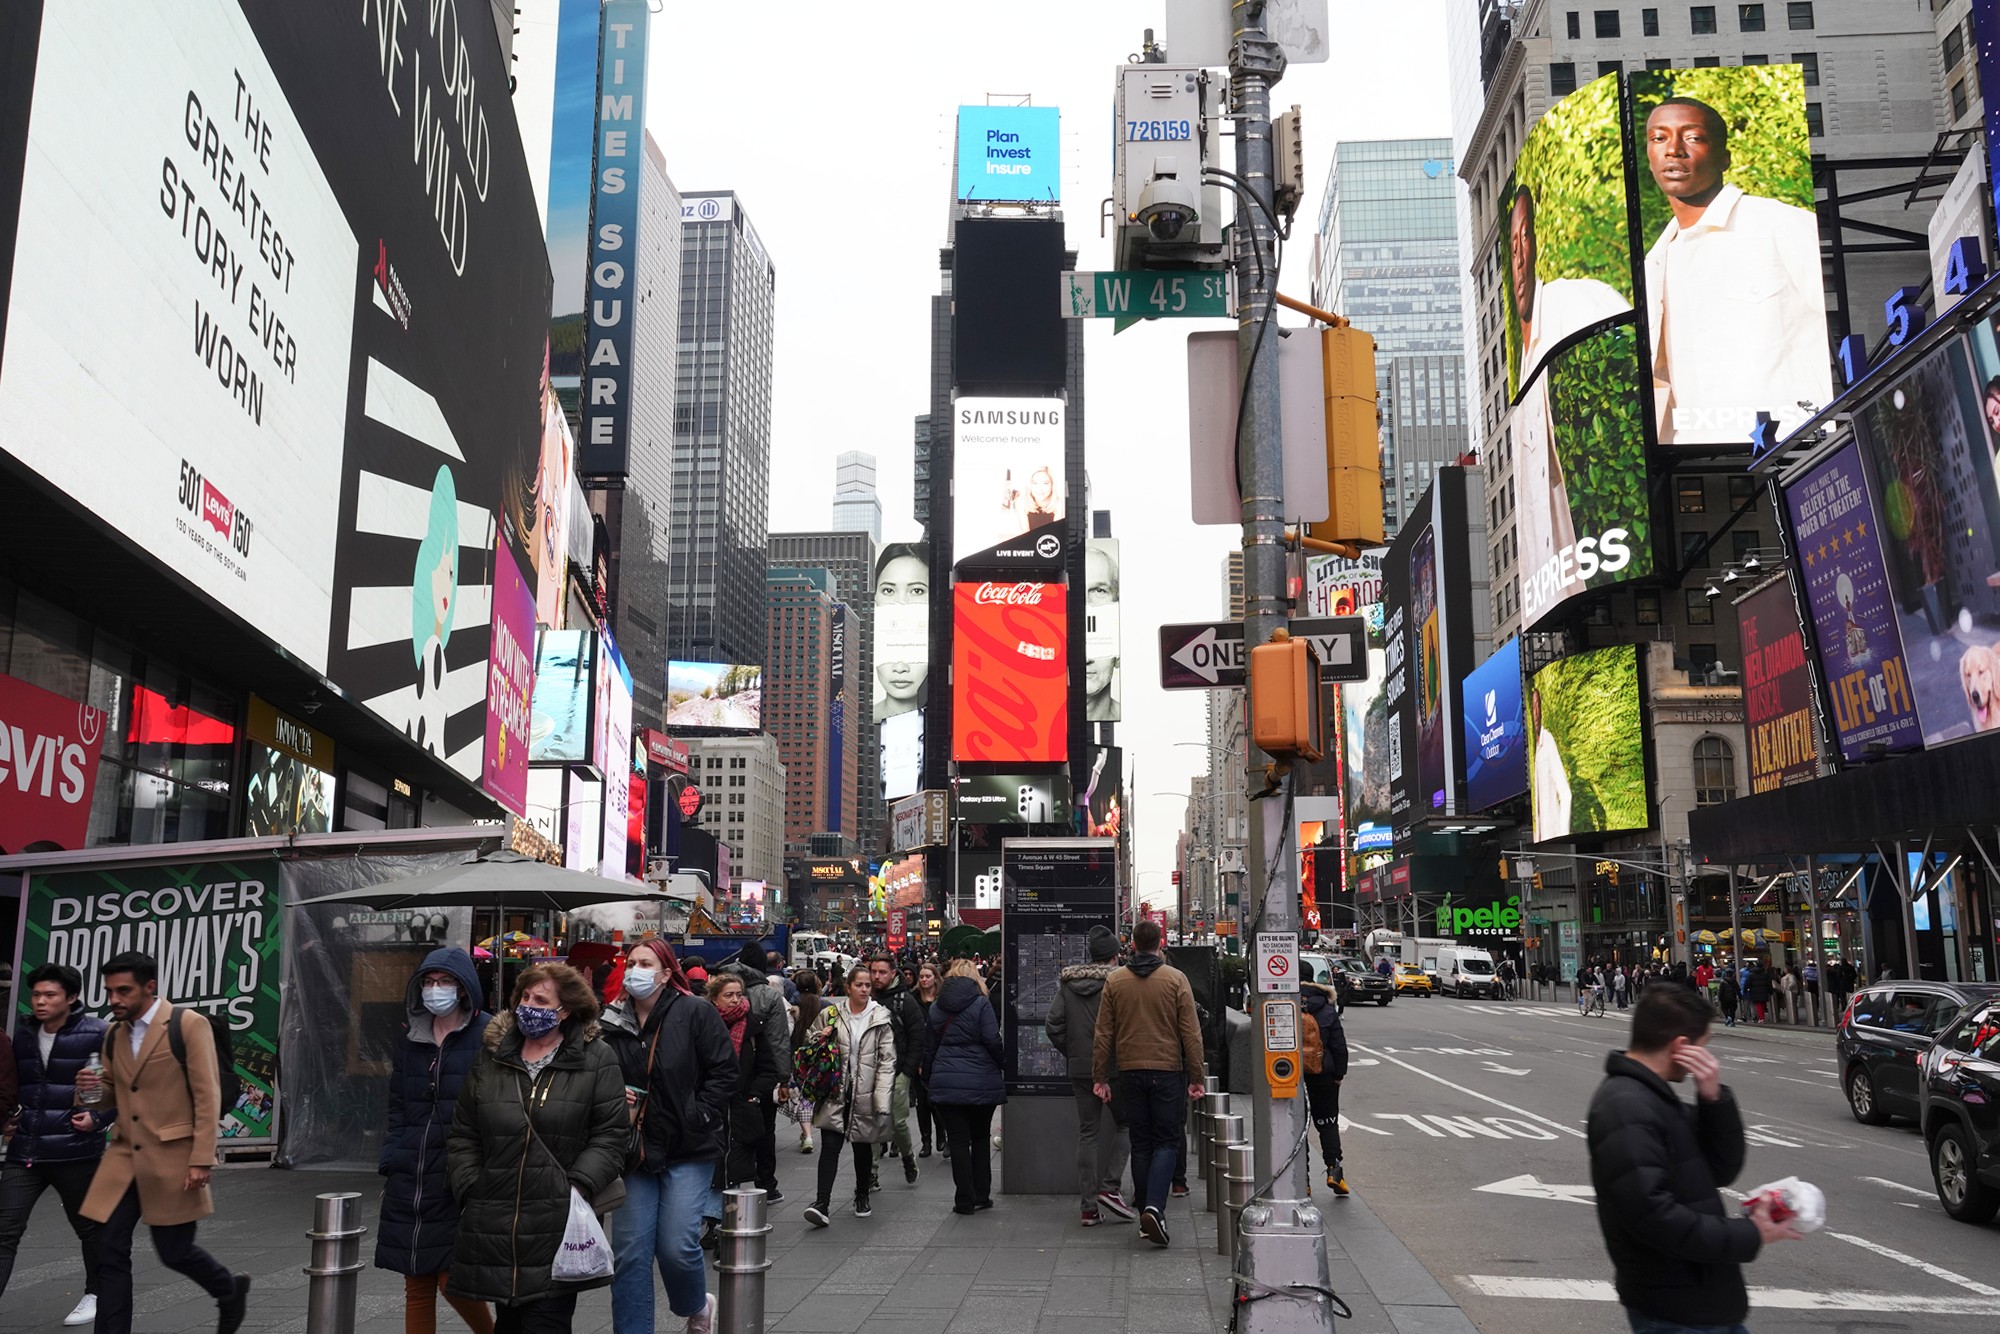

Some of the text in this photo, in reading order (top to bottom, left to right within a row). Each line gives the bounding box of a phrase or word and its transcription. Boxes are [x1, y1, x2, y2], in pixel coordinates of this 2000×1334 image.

[234, 67, 272, 175] THE
[601, 23, 633, 194] TIMES
[987, 130, 1019, 142] Plan
[987, 146, 1031, 158] Invest
[415, 48, 467, 277] WILD
[986, 161, 1032, 175] Insure
[185, 89, 294, 294] GREATEST
[161, 157, 296, 384] STORY EVER
[1104, 277, 1223, 312] W 45 St
[590, 223, 625, 445] SQUARE
[195, 298, 263, 427] WORN
[961, 410, 1059, 425] SAMSUNG
[961, 435, 1041, 443] Welcome home
[1800, 474, 1851, 521] BELIEVE IN THE
[1809, 481, 1820, 496] WILL
[1818, 473, 1830, 489] MAKE
[1829, 467, 1839, 481] YOU
[175, 517, 186, 534] 150
[187, 525, 205, 549] YEARS
[205, 541, 213, 554] OF
[213, 547, 223, 563] THE
[233, 508, 251, 558] 150
[1796, 515, 1819, 541] POWER
[1818, 508, 1828, 527] OF
[1316, 555, 1384, 582] LITTLE SH
[1524, 527, 1631, 617] EXPRESS
[975, 582, 1045, 605] Coca-Cola
[1317, 580, 1383, 616] HROR
[1192, 642, 1245, 667] ONE
[1743, 616, 1758, 652] THE
[495, 614, 530, 699] NOW WITH
[1745, 631, 1807, 689] NEIL DIAMON
[1747, 678, 1784, 724] MUSICAL
[1830, 655, 1911, 733] LIFE OF PI
[1480, 722, 1504, 747] Clear Channel
[1680, 710, 1702, 720] THE
[275, 717, 313, 758] INVICTA
[1751, 708, 1817, 776] A BEAUTIFUL
[932, 793, 944, 843] HELLO!
[51, 880, 264, 926] DISCOVER
[892, 912, 902, 934] tkts
[1453, 896, 1520, 934] pelé
[1339, 1113, 1559, 1140] ONLY
